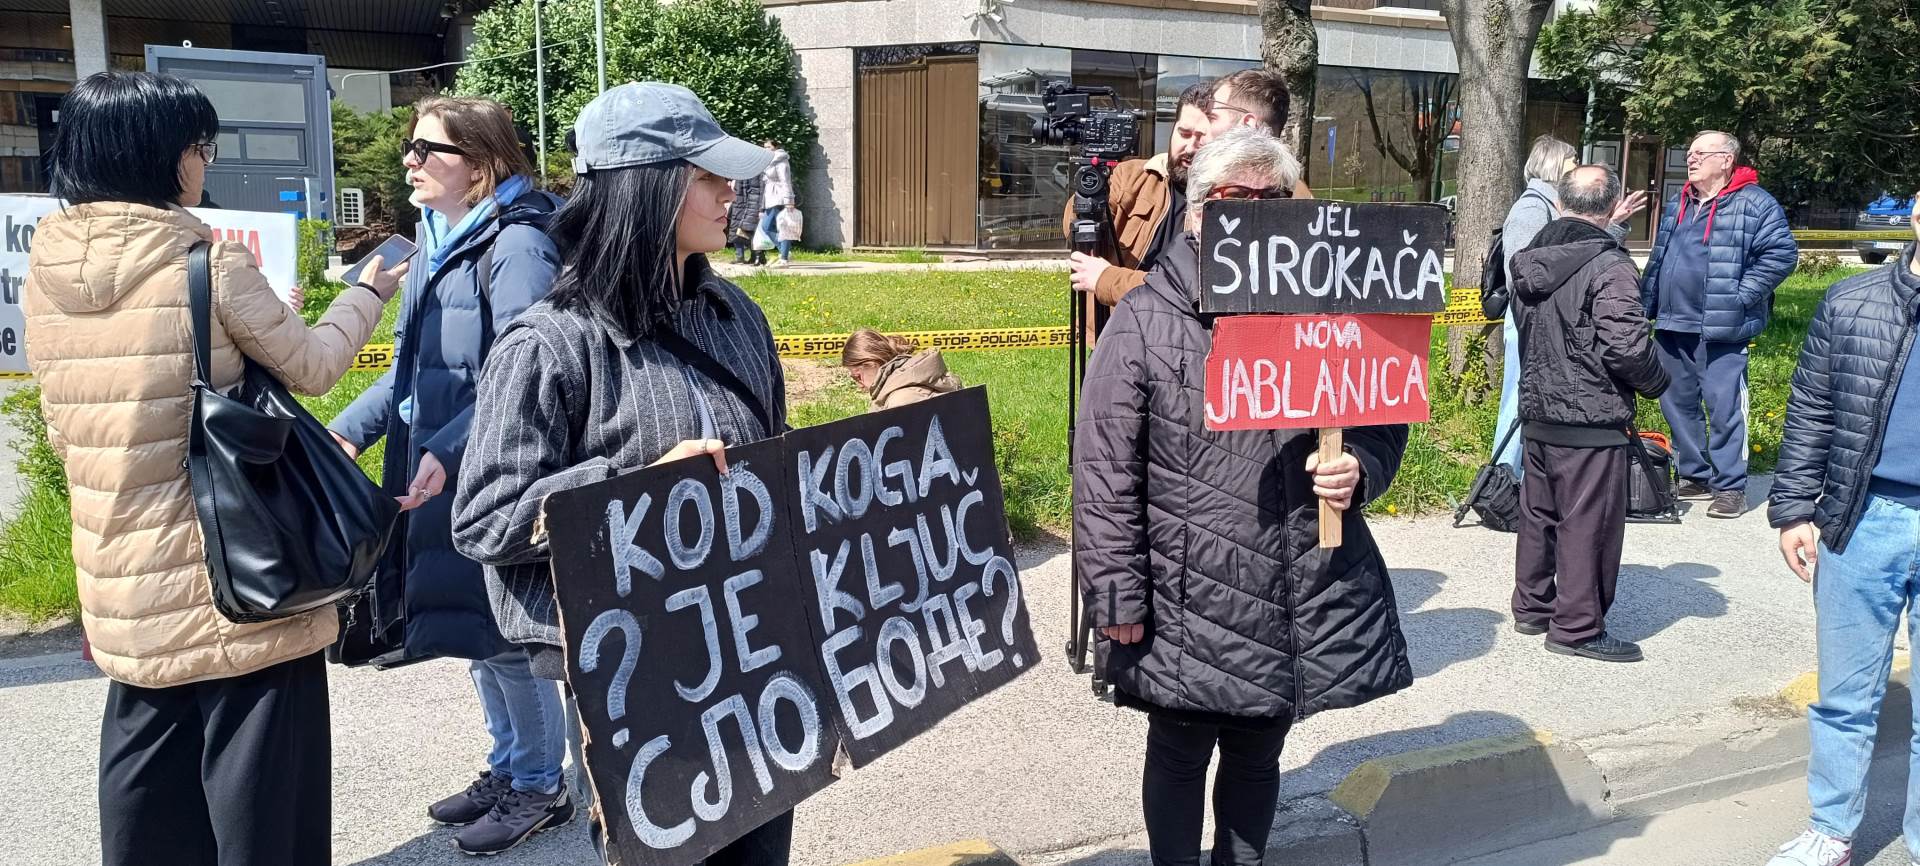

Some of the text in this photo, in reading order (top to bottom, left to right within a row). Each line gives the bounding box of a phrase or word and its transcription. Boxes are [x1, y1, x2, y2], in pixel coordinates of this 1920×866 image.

[5, 214, 41, 253] ko
[1308, 204, 1360, 237] JEL
[1212, 214, 1445, 302] ŠIROKAČA
[1, 268, 26, 305] tr
[1444, 311, 1471, 320] STOP
[804, 341, 845, 351] STOP
[933, 336, 970, 346] STOP
[980, 333, 1039, 345] POLICIJA
[1295, 320, 1361, 349] NOVA
[358, 353, 386, 364] OP
[1206, 354, 1427, 424] JABLANICA
[607, 414, 960, 597] KOD KOGA
[810, 467, 994, 635] KLJUČ
